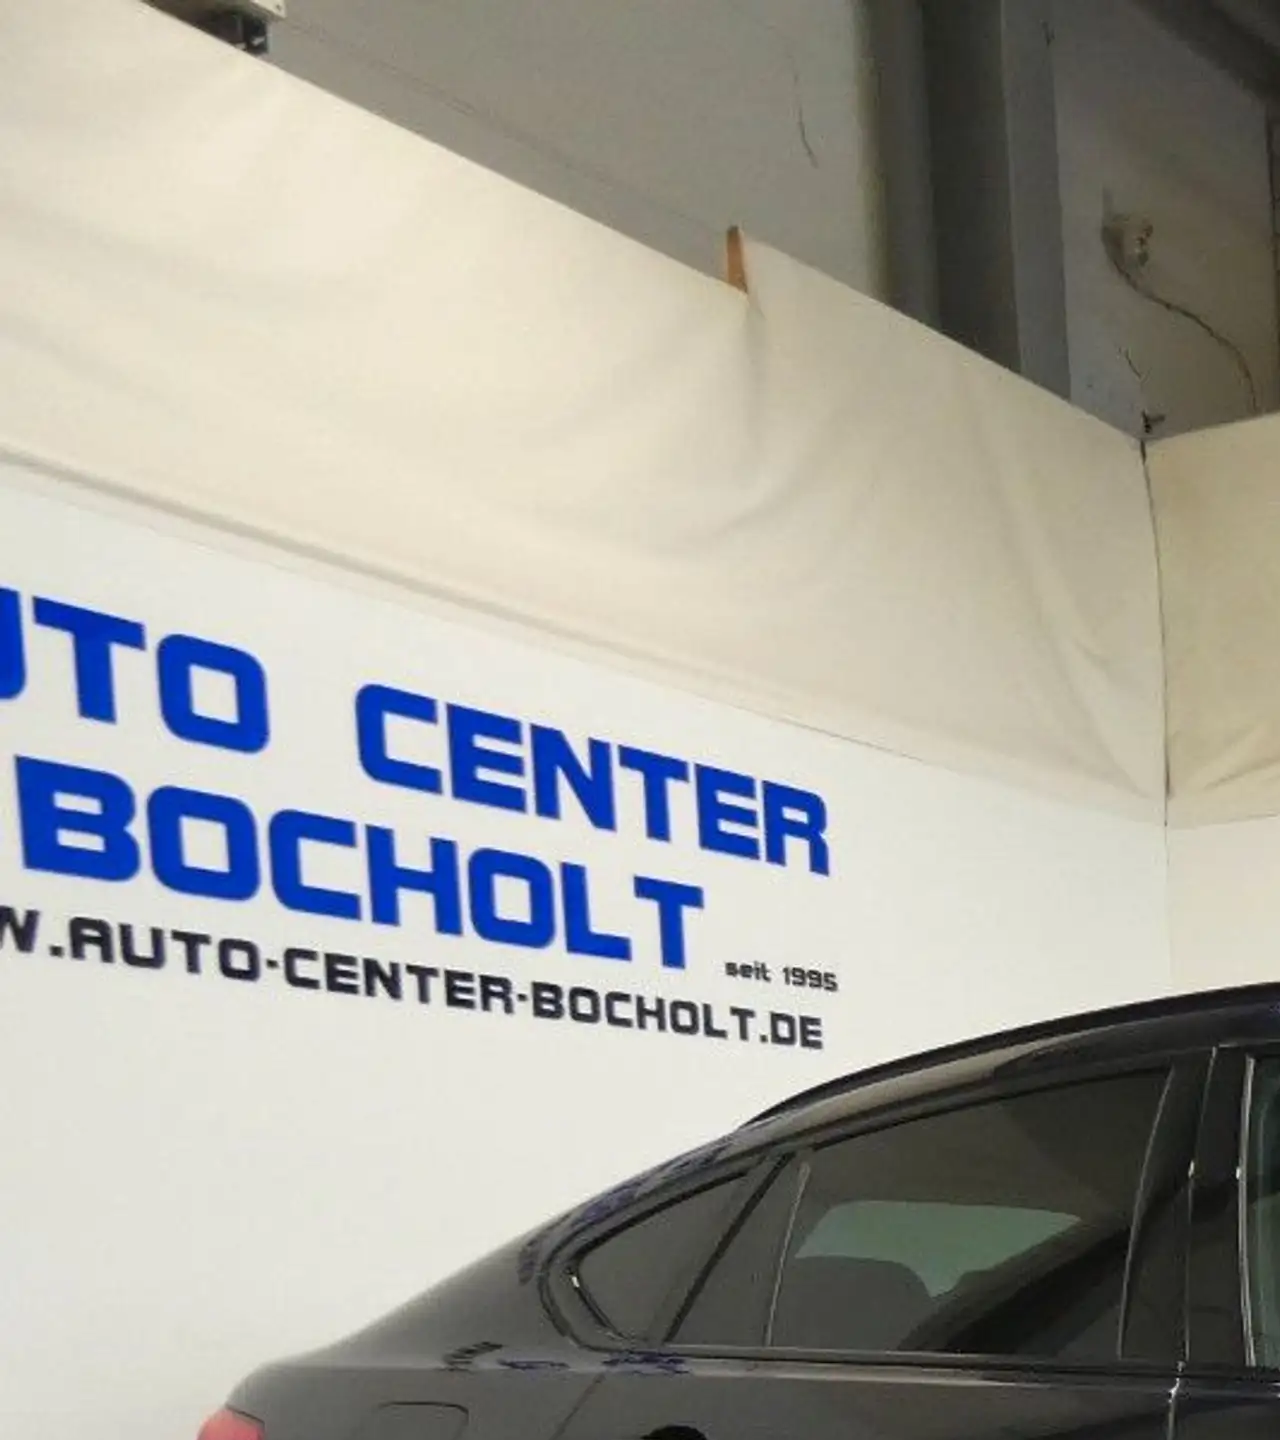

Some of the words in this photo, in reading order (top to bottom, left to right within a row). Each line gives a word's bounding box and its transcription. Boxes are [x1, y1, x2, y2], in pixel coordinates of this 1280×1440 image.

[0, 587, 270, 753] TO
[356, 684, 829, 874] CENTER
[16, 757, 704, 969] BOCHOLT
[725, 961, 771, 983] seit
[782, 966, 838, 992] 1995
